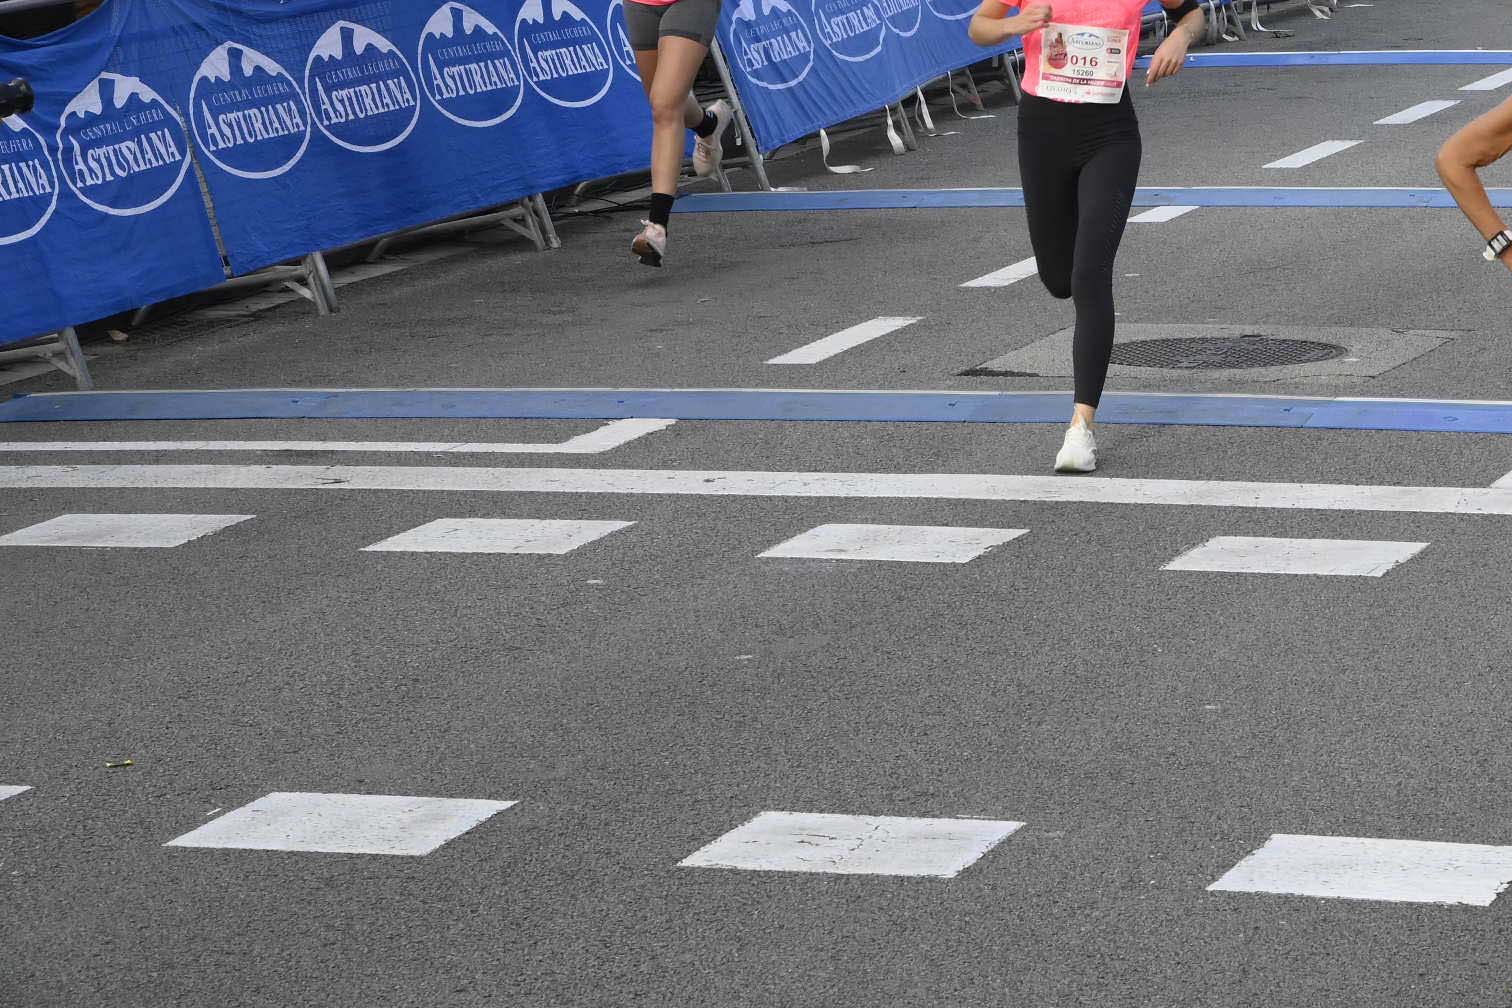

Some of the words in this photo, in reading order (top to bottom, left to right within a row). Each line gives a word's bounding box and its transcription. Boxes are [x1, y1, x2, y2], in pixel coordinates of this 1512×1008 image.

[325, 68, 362, 83] CENTRAL
[364, 58, 399, 76] LECHERA
[428, 53, 519, 100] ASTURIANA
[524, 38, 608, 82] ASTURIANA
[1070, 54, 1098, 67] 016
[315, 76, 415, 125] ASTURIANA
[201, 99, 305, 151] ASTURIANA
